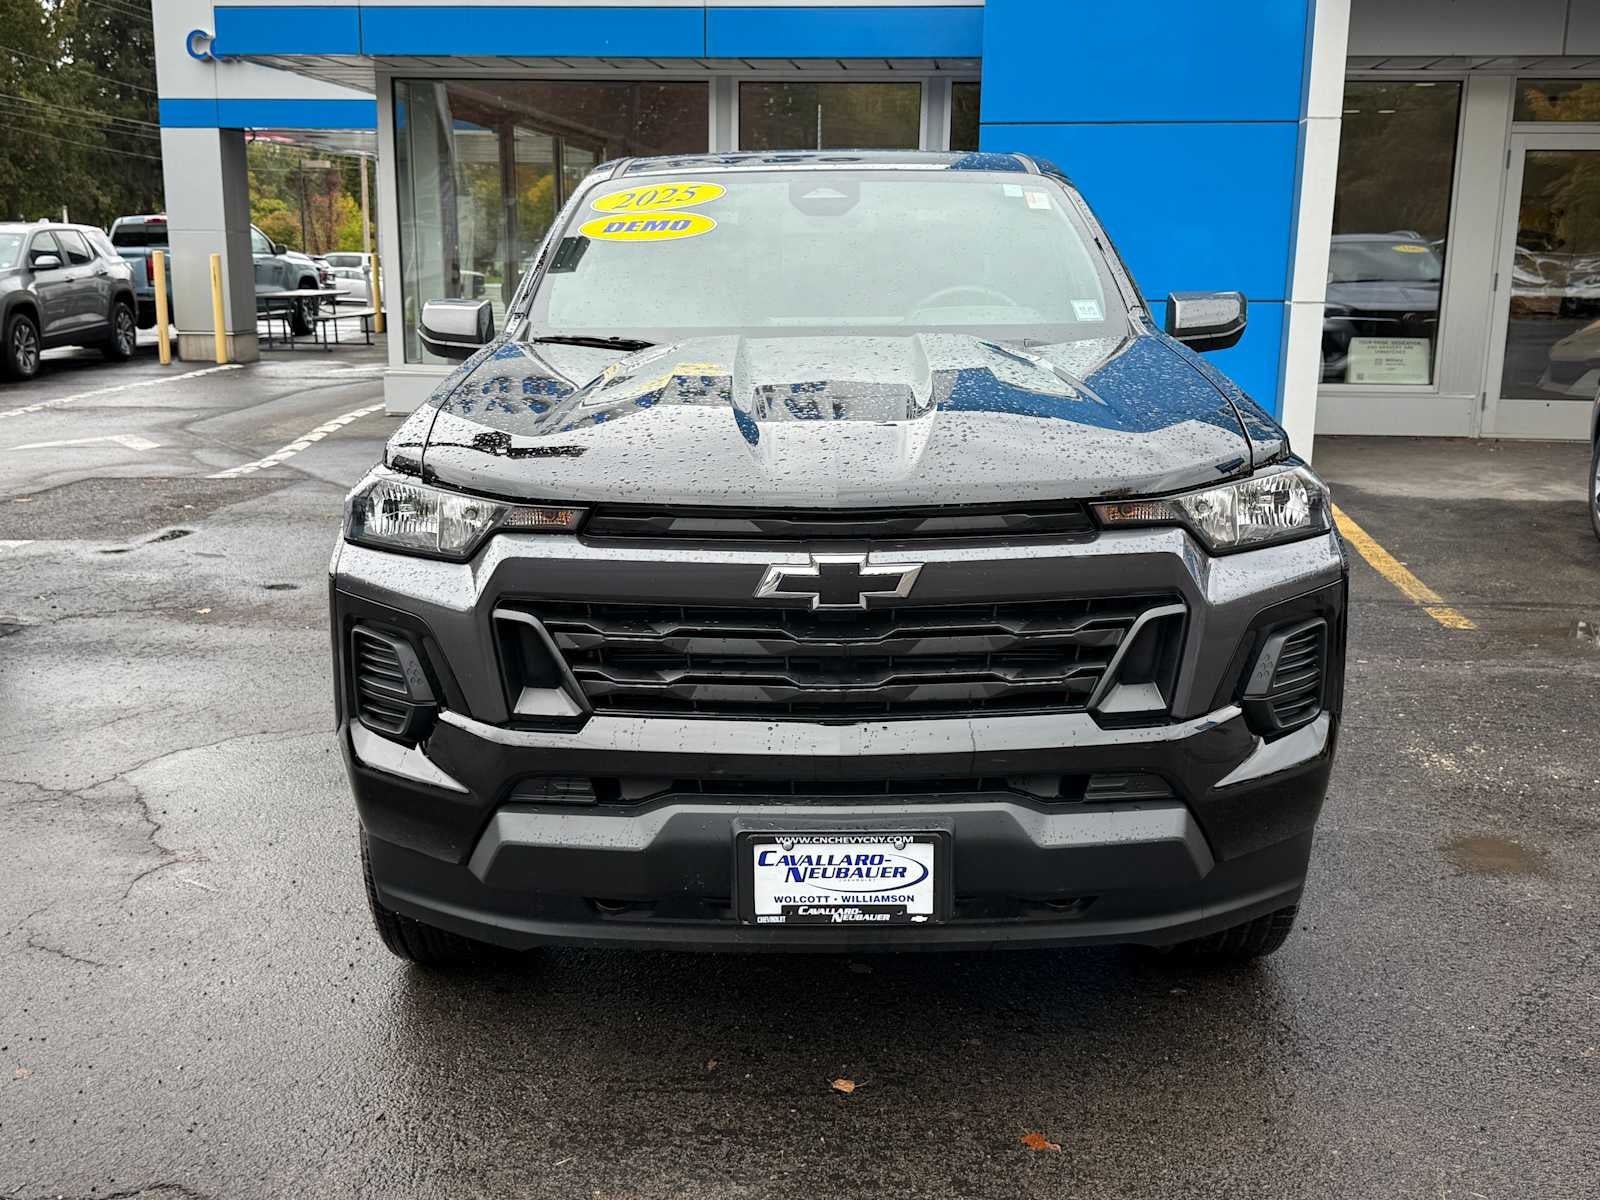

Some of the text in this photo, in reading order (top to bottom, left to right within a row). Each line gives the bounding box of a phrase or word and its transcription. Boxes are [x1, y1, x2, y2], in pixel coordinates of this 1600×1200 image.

[611, 186, 702, 210] 2025
[603, 219, 692, 233] DEMO
[775, 836, 914, 844] WWW.CNCHEVYCNY.COM
[758, 850, 893, 867] CAVALLARO-
[785, 866, 907, 883] NEUBAUER
[774, 894, 915, 904] WOLCOTT WILLIAMSON
[831, 912, 890, 923] NEUBAUER
